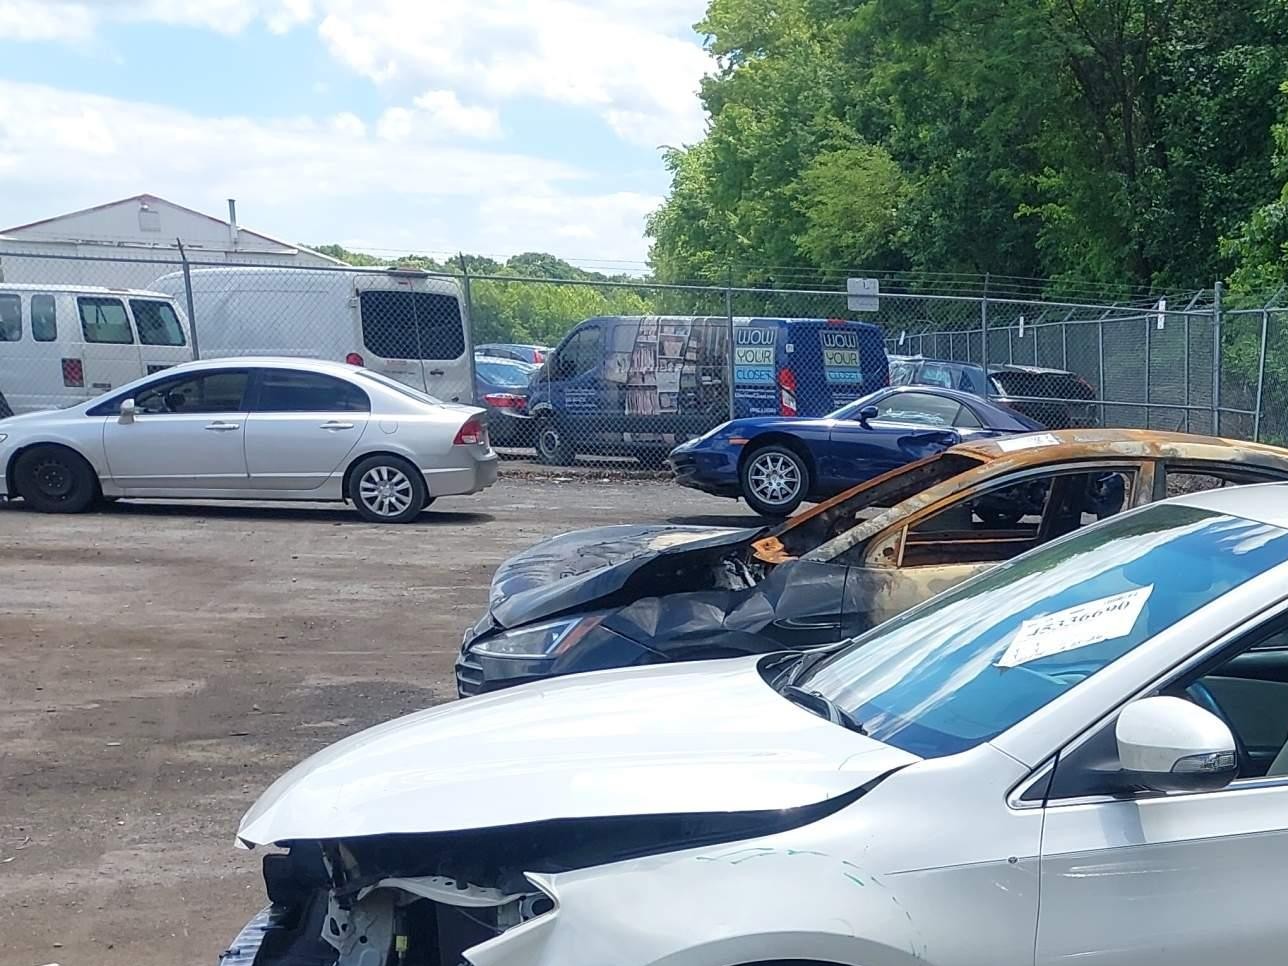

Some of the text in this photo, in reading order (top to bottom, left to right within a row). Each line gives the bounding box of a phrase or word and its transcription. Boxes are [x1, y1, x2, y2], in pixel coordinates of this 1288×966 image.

[738, 329, 774, 345] WOW
[823, 334, 856, 348] WOW
[737, 350, 772, 363] YOUR
[826, 353, 858, 365] YOUR
[736, 369, 772, 380] CLOSET
